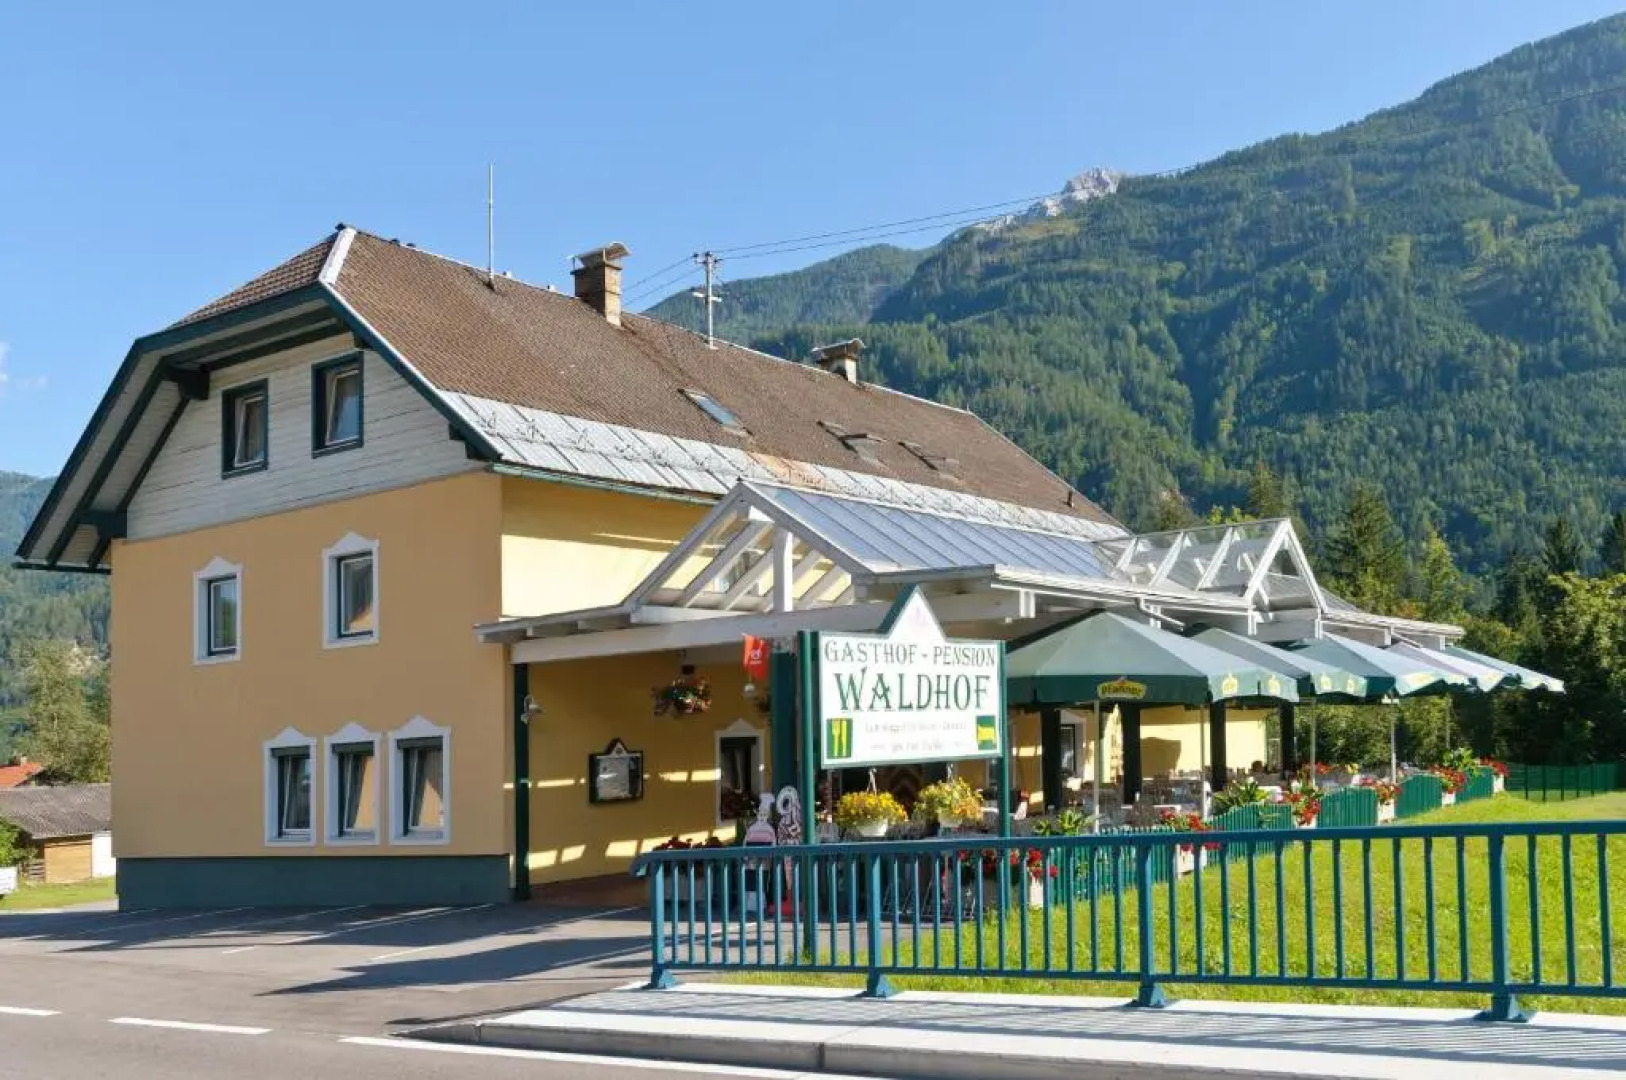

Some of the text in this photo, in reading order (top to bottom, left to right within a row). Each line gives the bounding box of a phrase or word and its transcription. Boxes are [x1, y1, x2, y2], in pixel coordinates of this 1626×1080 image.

[825, 640, 918, 664] GASTHOF
[933, 645, 995, 667] PENSION
[834, 666, 991, 712] WALDHOF
